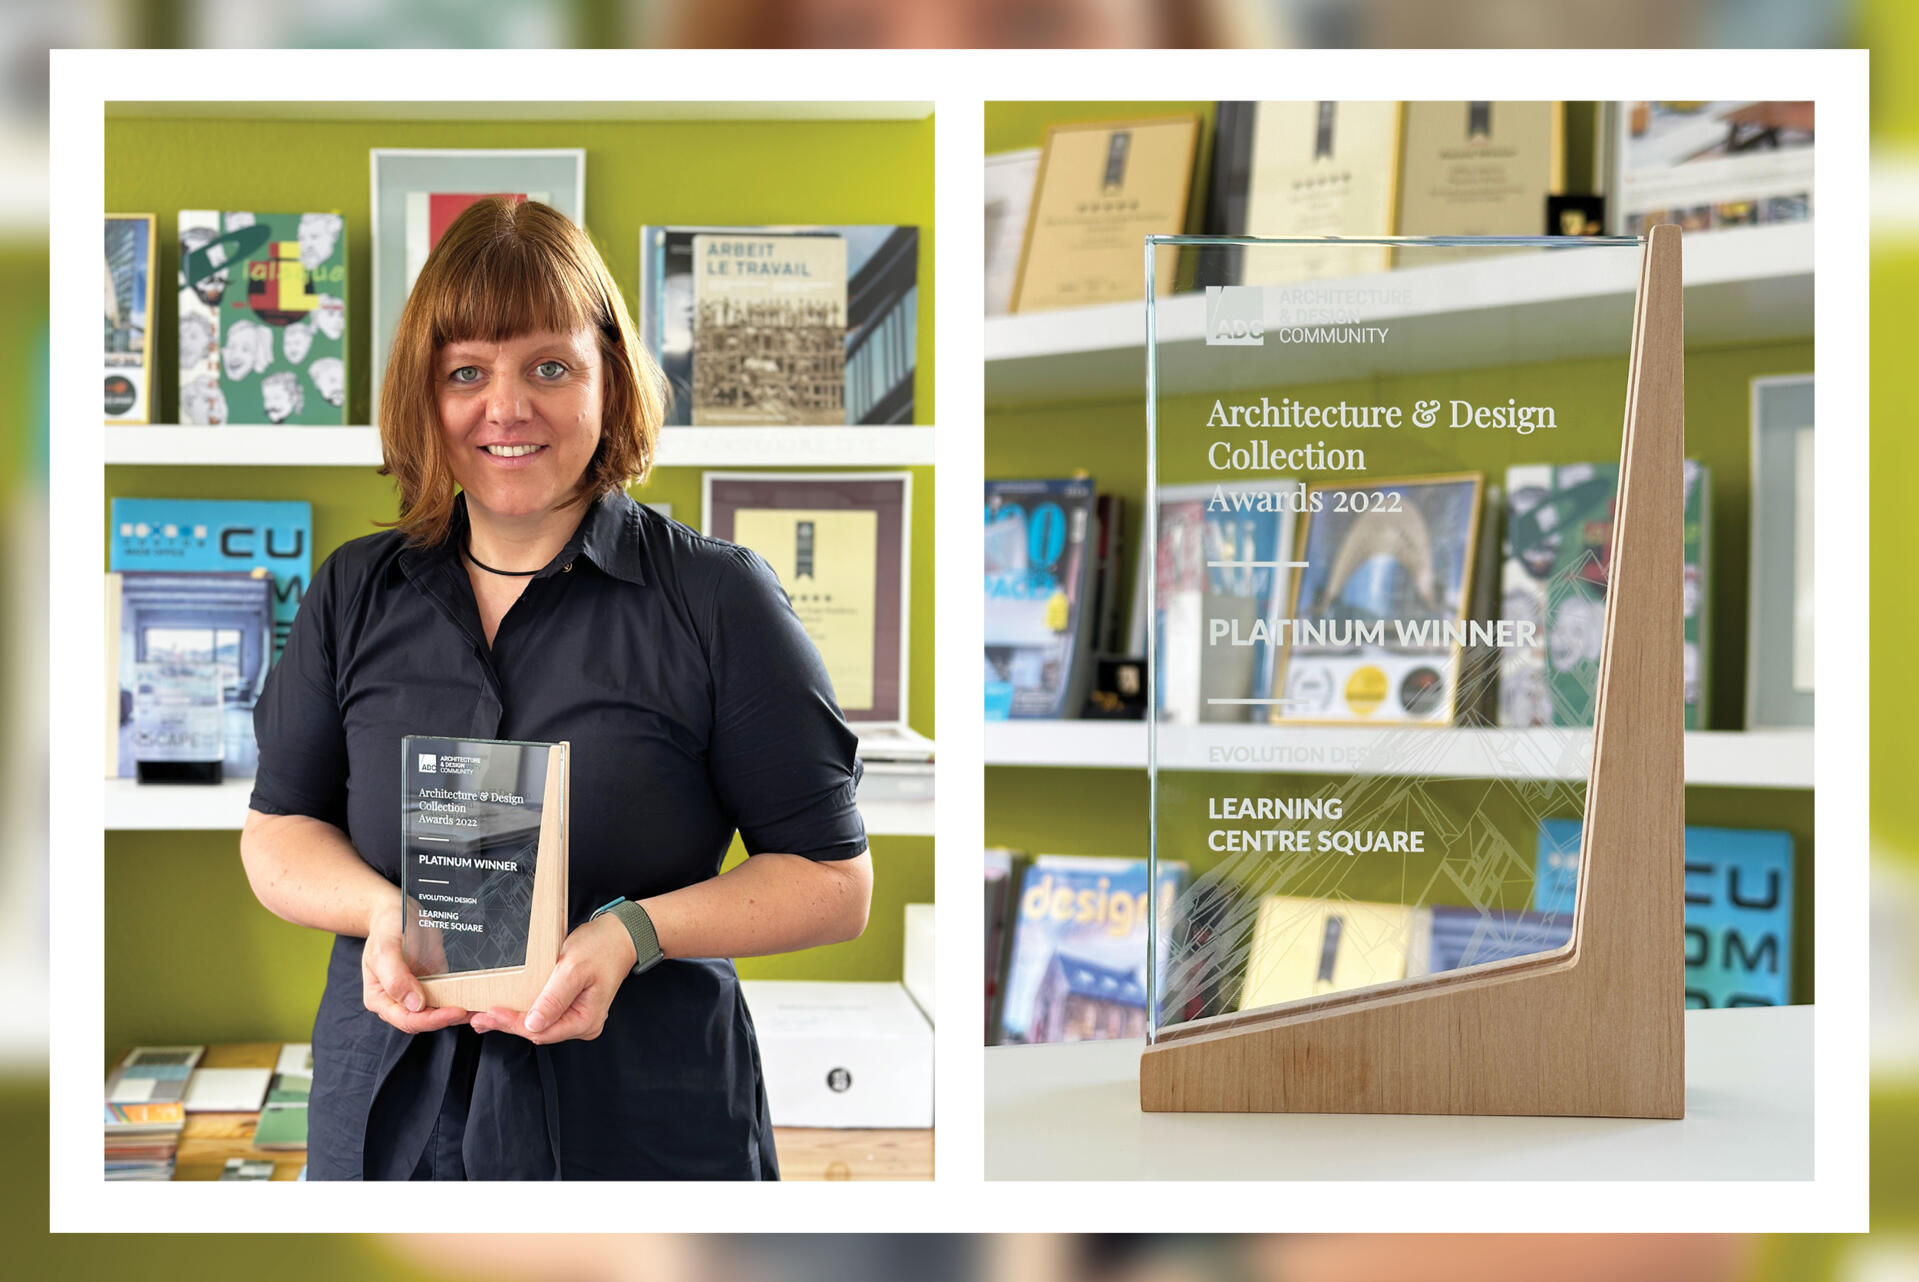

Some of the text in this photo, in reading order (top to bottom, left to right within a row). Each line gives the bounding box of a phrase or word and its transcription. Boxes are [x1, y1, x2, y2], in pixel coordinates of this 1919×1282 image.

[707, 242, 775, 257] ARBEIT
[707, 260, 811, 277] LE TRAVAIL
[1280, 289, 1412, 305] ARCHITECTURE
[1296, 309, 1361, 324] DESIGN
[1215, 320, 1264, 340] ADC
[1279, 328, 1390, 344] COMMUNITY
[1206, 397, 1557, 434] Architecture & Design
[1208, 440, 1367, 471] Collection
[1206, 483, 1403, 513] Awards 2022
[1209, 619, 1538, 648] PLATINUM WINNER
[440, 755, 480, 764] ARCHITECTURE
[1209, 746, 1325, 764] EVOLUTION
[422, 763, 437, 771] ADC
[419, 787, 524, 806] Architecture & Design
[419, 801, 466, 813] Collection
[1209, 798, 1343, 820] LEARNING
[418, 814, 478, 827] Awards 2022
[1208, 830, 1425, 855] CENTRE SQUARE
[419, 854, 518, 872] PLATINUM WINNER
[419, 893, 478, 905] EVOLUTION DESIGN
[419, 909, 459, 920] LEARNING
[418, 919, 484, 933] CENTRE SQUARE
